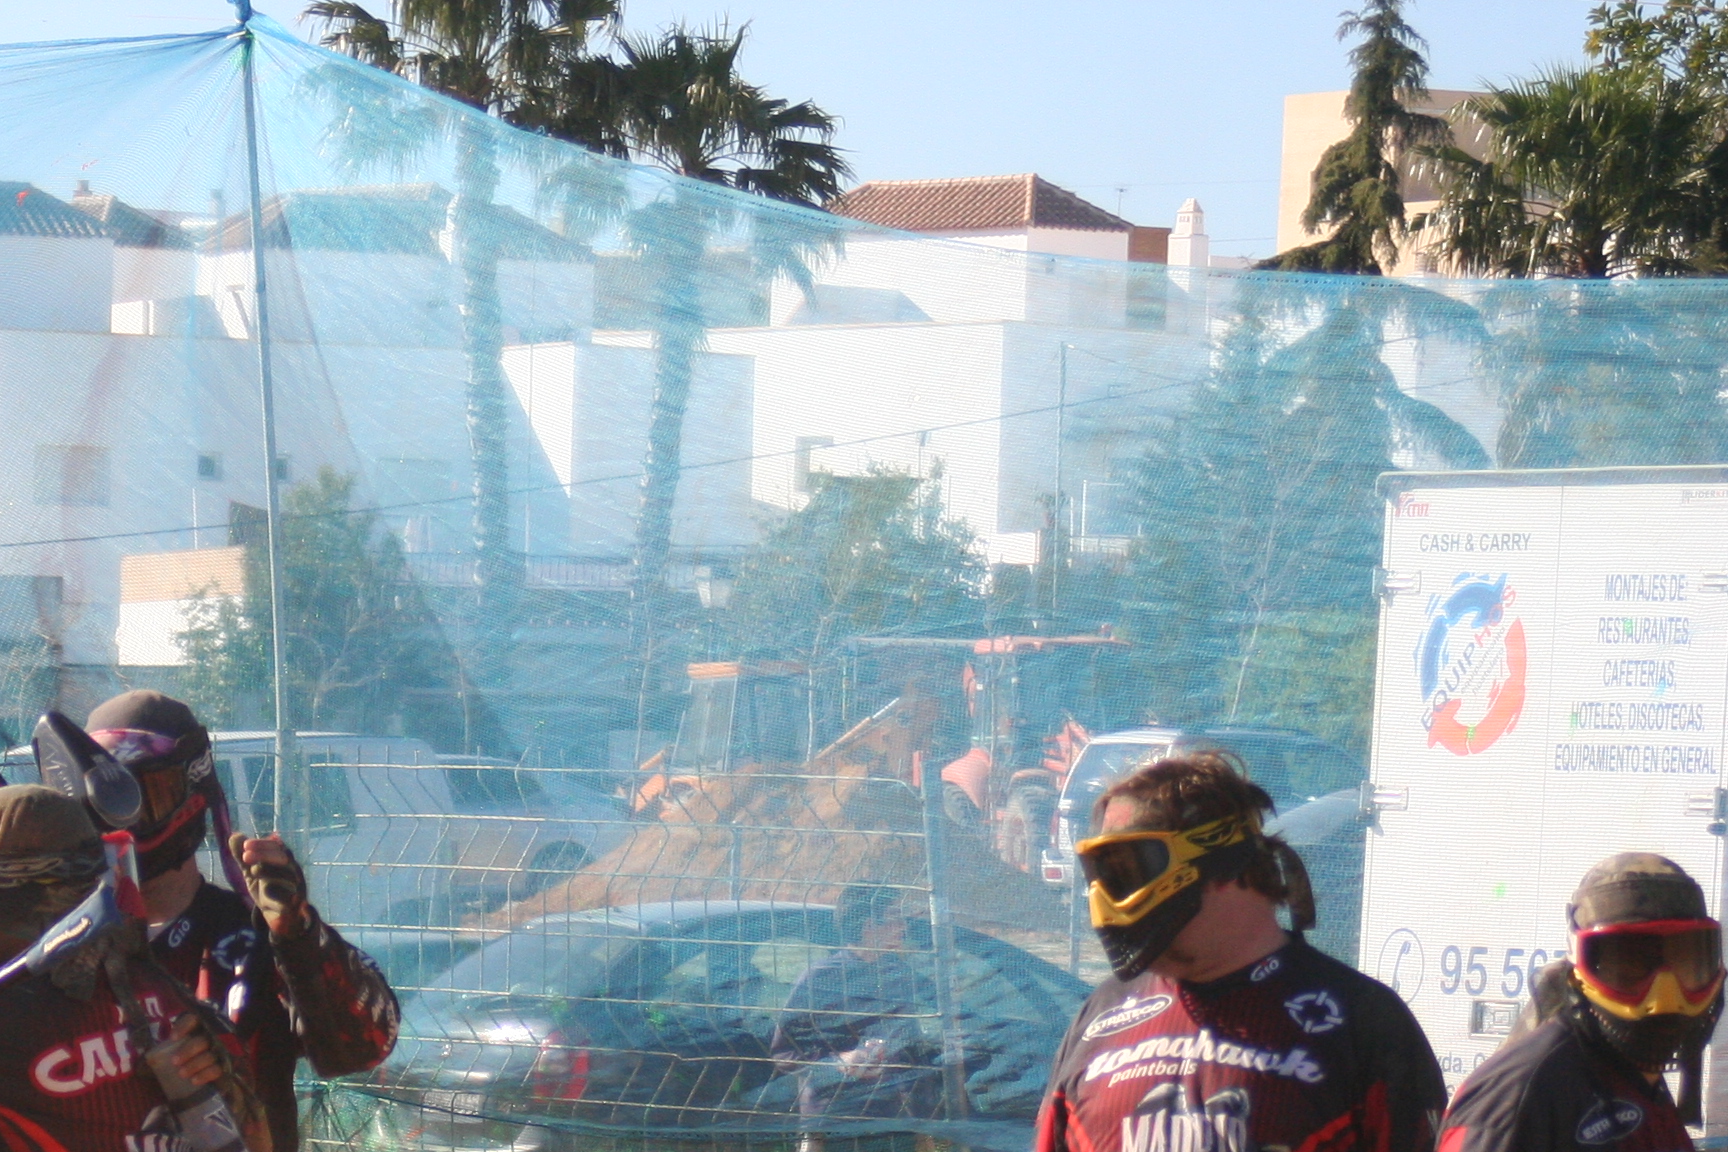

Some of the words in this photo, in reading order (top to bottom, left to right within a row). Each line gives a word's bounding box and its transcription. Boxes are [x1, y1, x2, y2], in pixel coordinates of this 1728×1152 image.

[1419, 533, 1460, 552] CASH
[1464, 533, 1475, 552] &
[1479, 533, 1531, 552] CARRY
[1604, 574, 1667, 602] MONTAJES
[1554, 744, 1640, 774] EQUIPAMIENTO
[1642, 746, 1659, 772] EN
[1661, 746, 1717, 775] GENERAL
[1440, 945, 1489, 996] 95
[1085, 1028, 1325, 1083] tomahawk
[1108, 1059, 1198, 1088] paintballs
